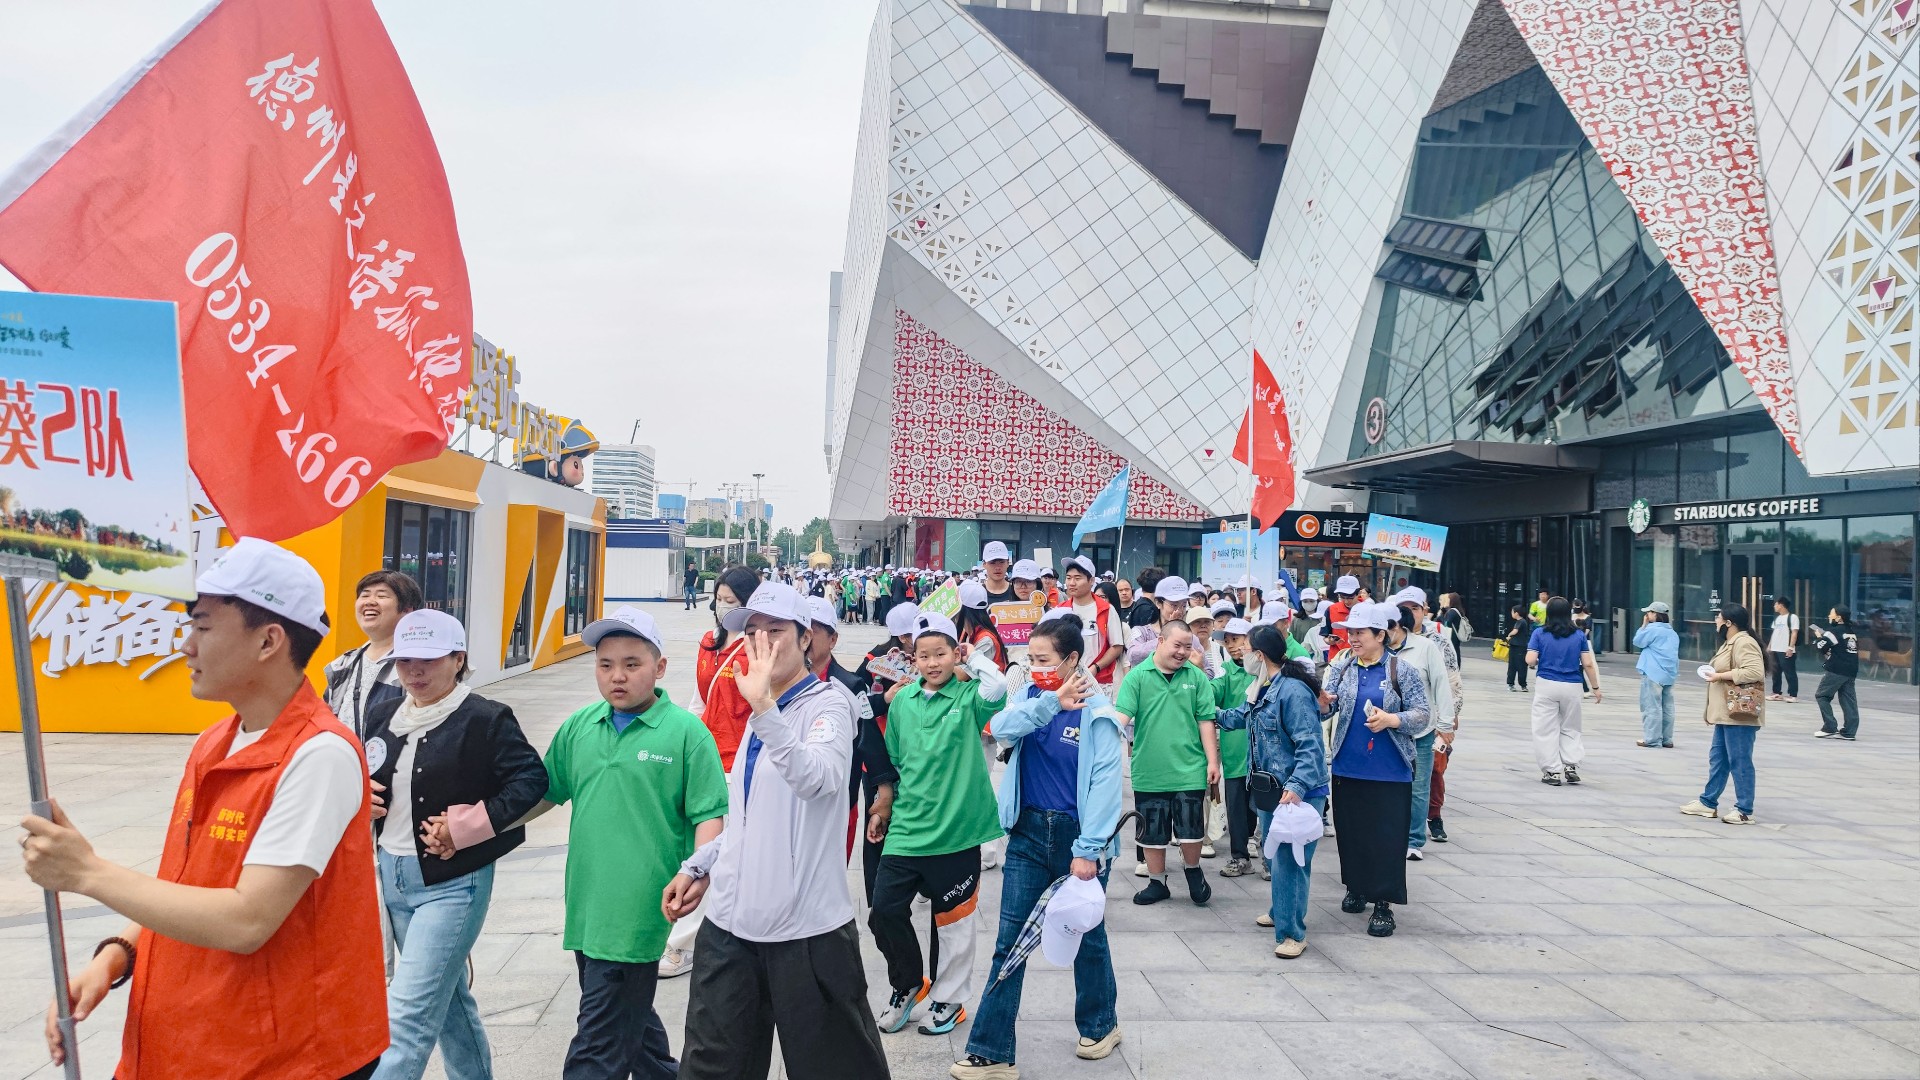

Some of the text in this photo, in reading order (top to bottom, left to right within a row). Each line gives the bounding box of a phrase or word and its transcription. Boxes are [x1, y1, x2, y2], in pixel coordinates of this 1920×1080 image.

[1673, 498, 1819, 521] STARBUCKS COFFEE
[1377, 530, 1431, 552] 向日葵3队
[37, 590, 193, 669] 储备
[998, 628, 1032, 640] 心爱行
[217, 807, 246, 826] 新时代
